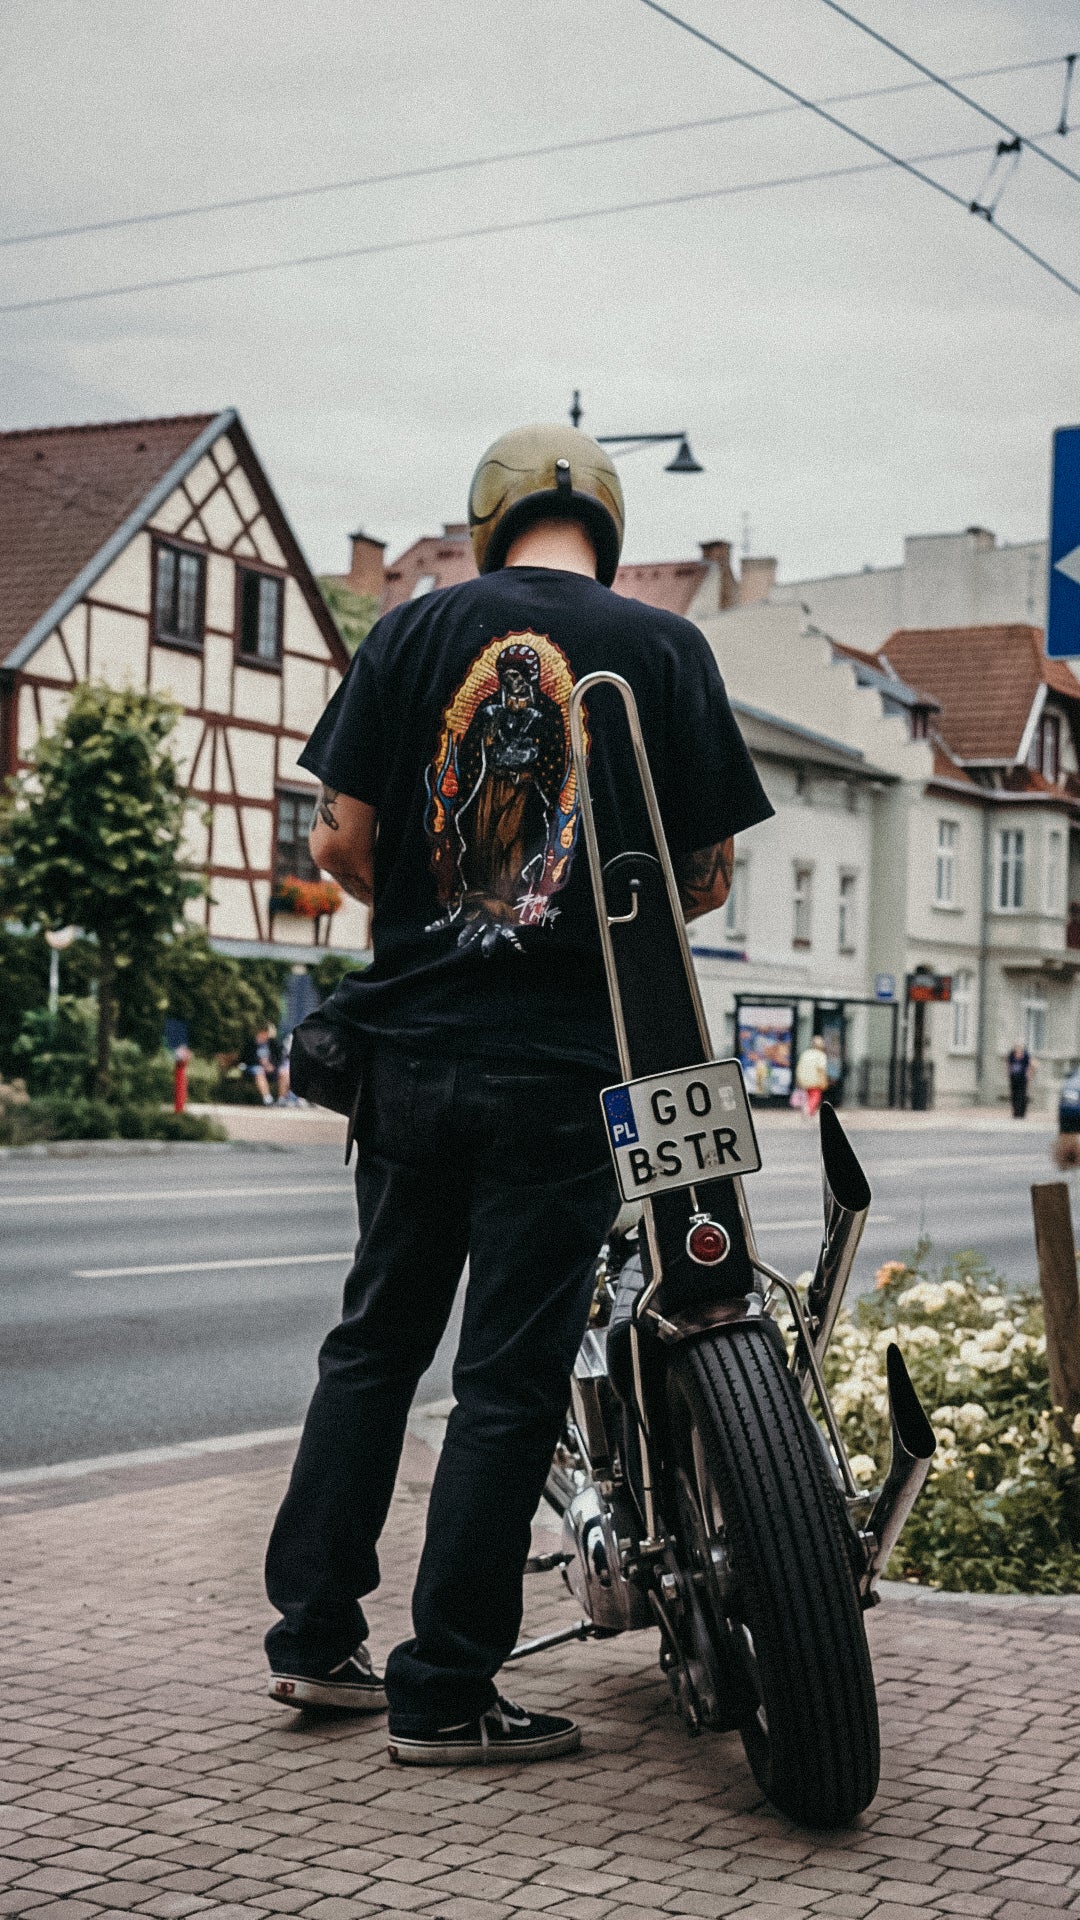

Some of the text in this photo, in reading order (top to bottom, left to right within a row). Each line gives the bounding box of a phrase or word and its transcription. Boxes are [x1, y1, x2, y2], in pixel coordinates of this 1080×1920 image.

[651, 1081, 711, 1125] GO
[612, 1121, 635, 1142] PL
[628, 1127, 741, 1186] BSTR
